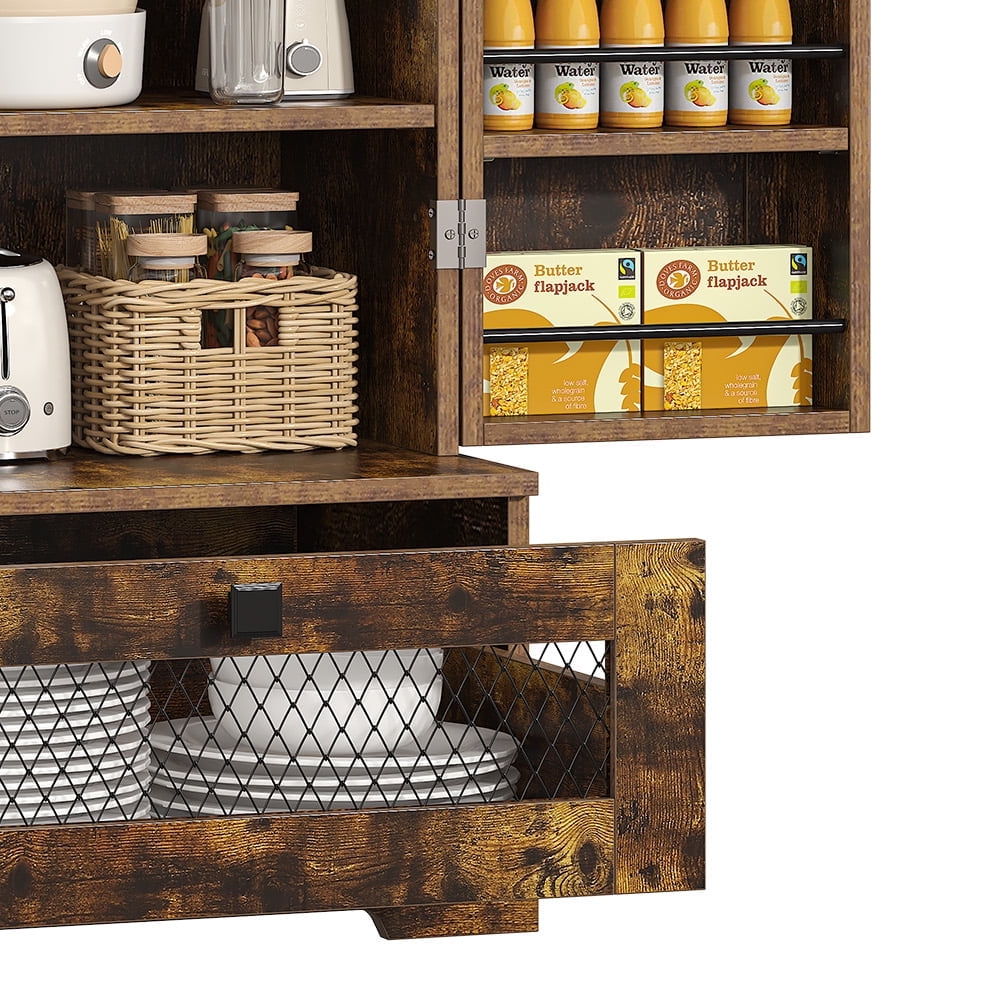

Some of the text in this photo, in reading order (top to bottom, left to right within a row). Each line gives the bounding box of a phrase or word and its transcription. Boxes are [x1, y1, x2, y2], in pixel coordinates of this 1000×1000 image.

[490, 66, 530, 78] Water
[555, 65, 596, 77] Water
[619, 64, 661, 75] Water
[684, 62, 726, 74] Water
[749, 62, 789, 73] Water
[534, 264, 583, 276] Butter
[707, 259, 755, 271] Butter
[534, 280, 595, 295] flapjack
[707, 275, 767, 290] flapjack
